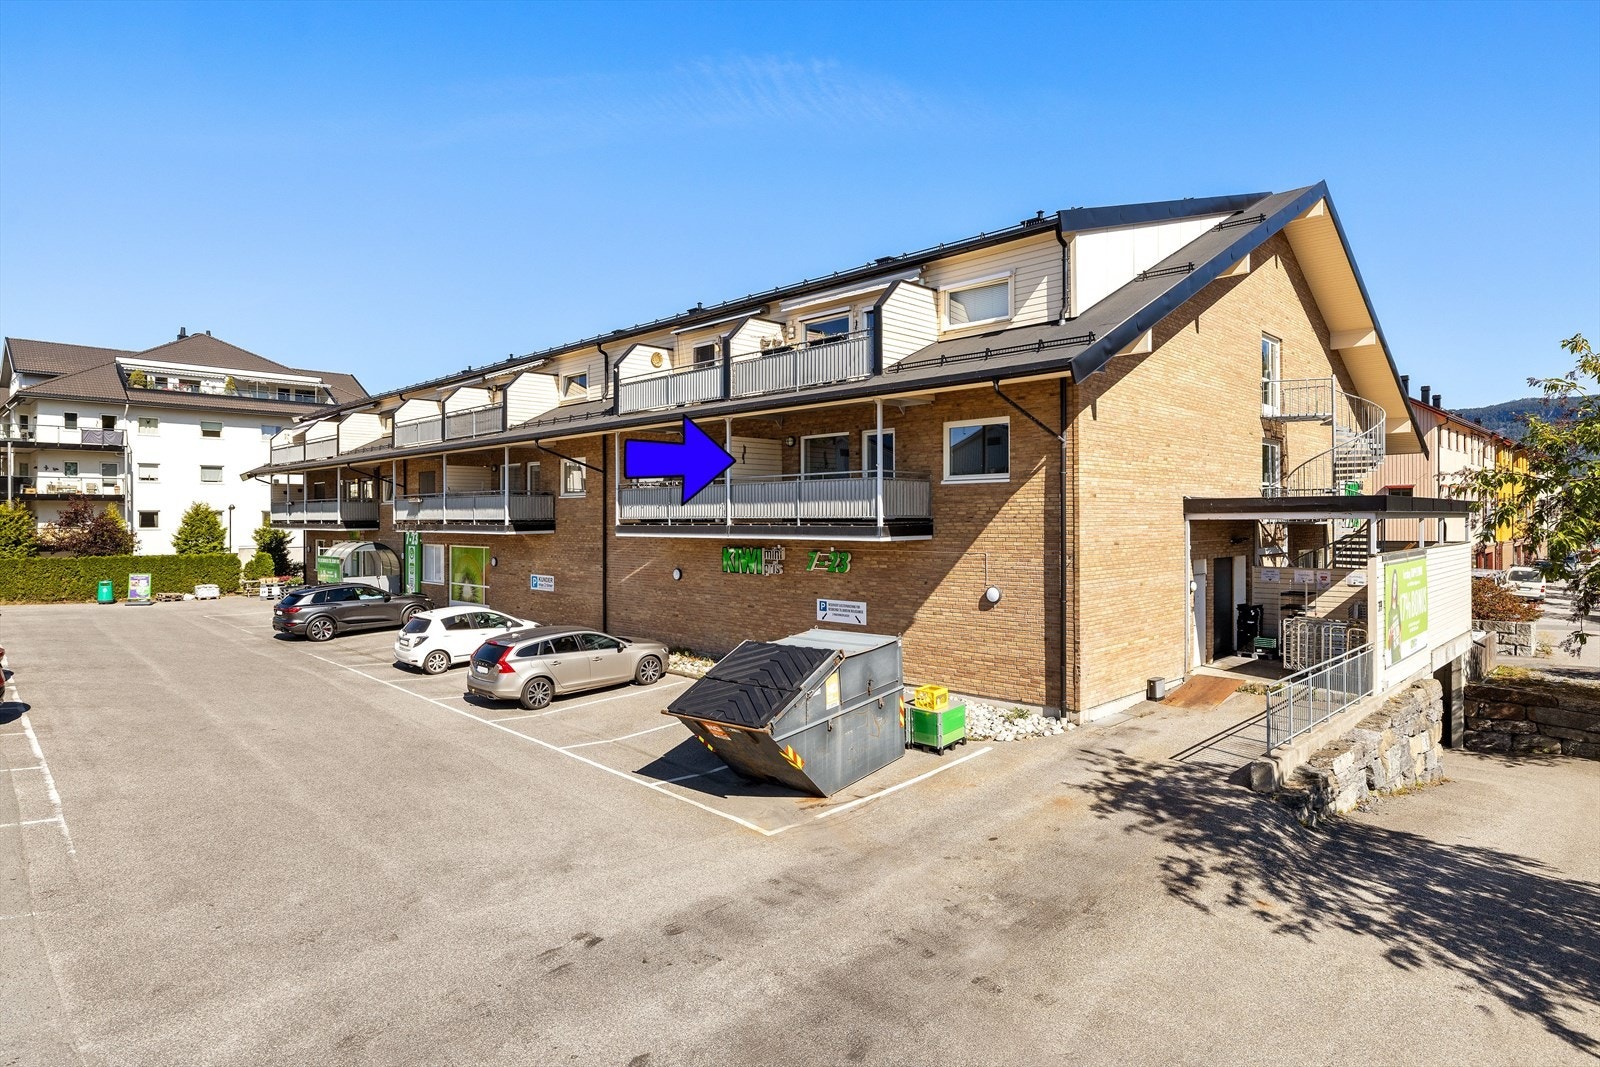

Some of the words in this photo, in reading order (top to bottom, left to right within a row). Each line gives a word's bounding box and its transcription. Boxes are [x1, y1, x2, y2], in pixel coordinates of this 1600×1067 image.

[722, 547, 762, 574] KIWI
[764, 546, 785, 560] mini
[806, 551, 851, 573] 7-23
[764, 563, 784, 576] pris
